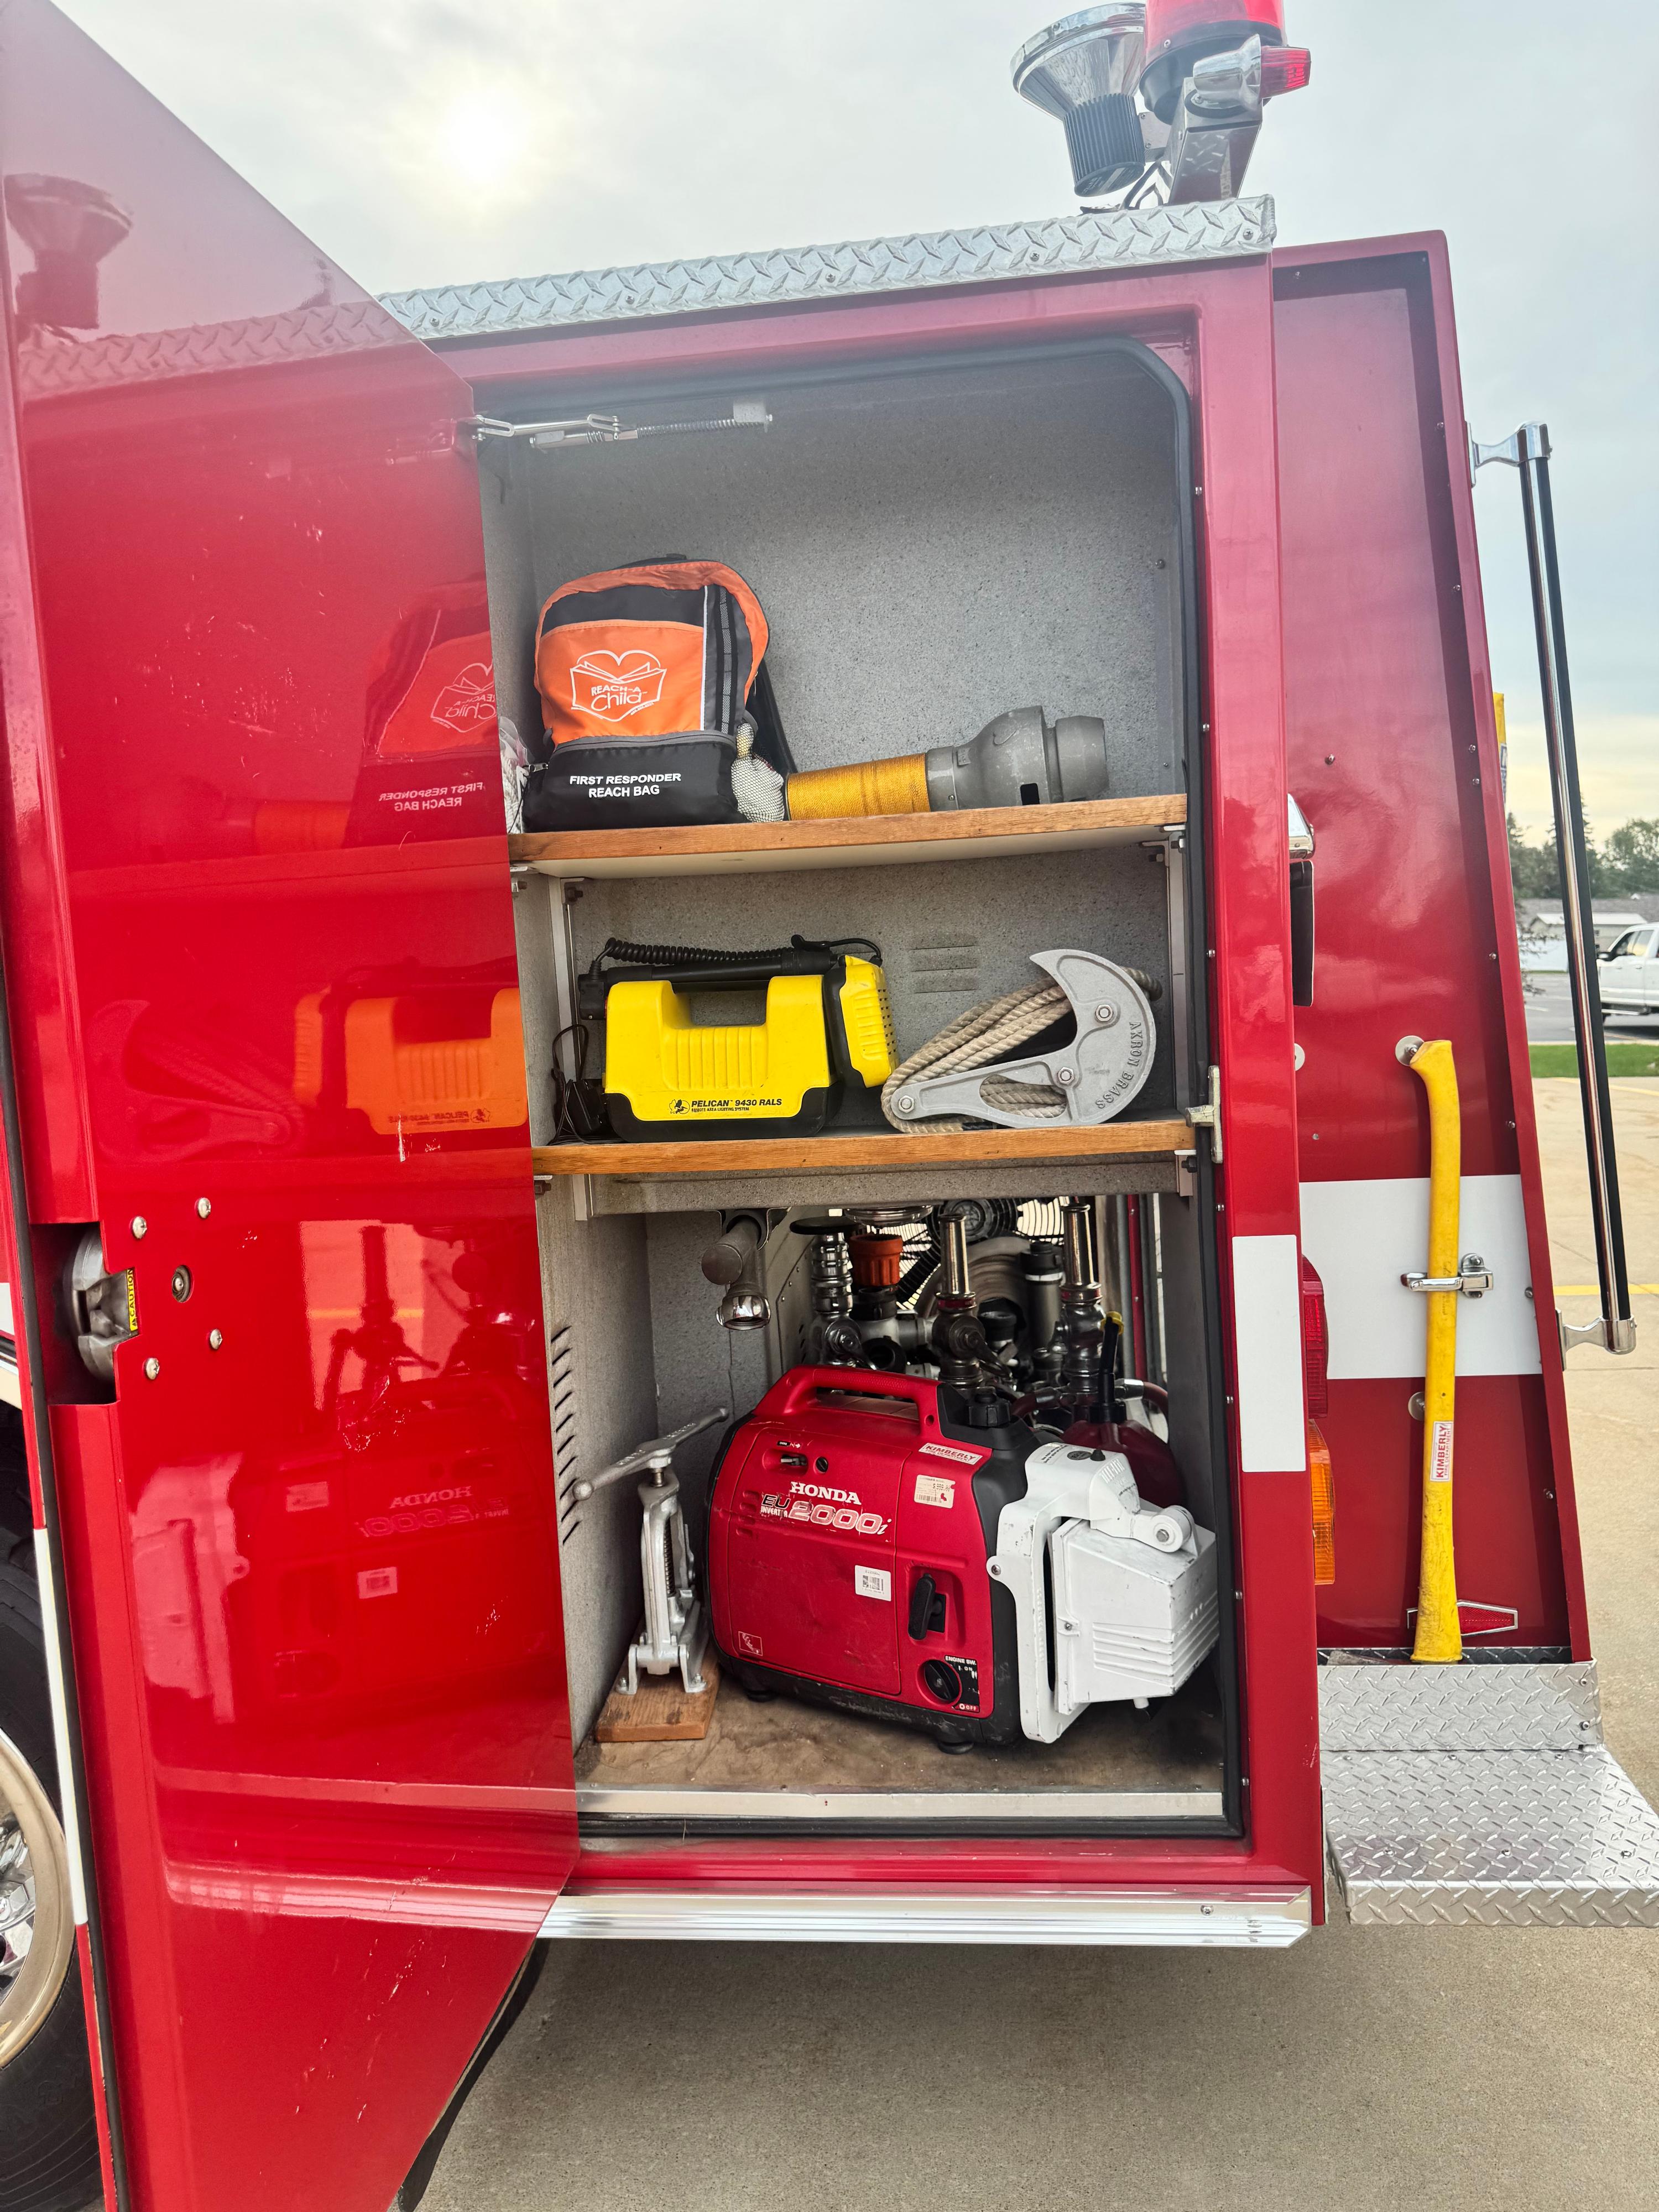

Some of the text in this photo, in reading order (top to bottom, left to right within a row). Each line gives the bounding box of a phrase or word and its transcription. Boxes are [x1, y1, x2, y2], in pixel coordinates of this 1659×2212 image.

[591, 685, 641, 696] REACH-A
[569, 773, 681, 785] FIRST RESPONDER
[588, 785, 660, 798] REACH BAG
[1095, 1021, 1143, 1109] AKRON BRASS
[926, 1446, 976, 1460] KIMBERLY
[1436, 1425, 1447, 1478] KIMBERLY
[790, 1481, 862, 1505] HONDA
[761, 1494, 791, 1510] EU
